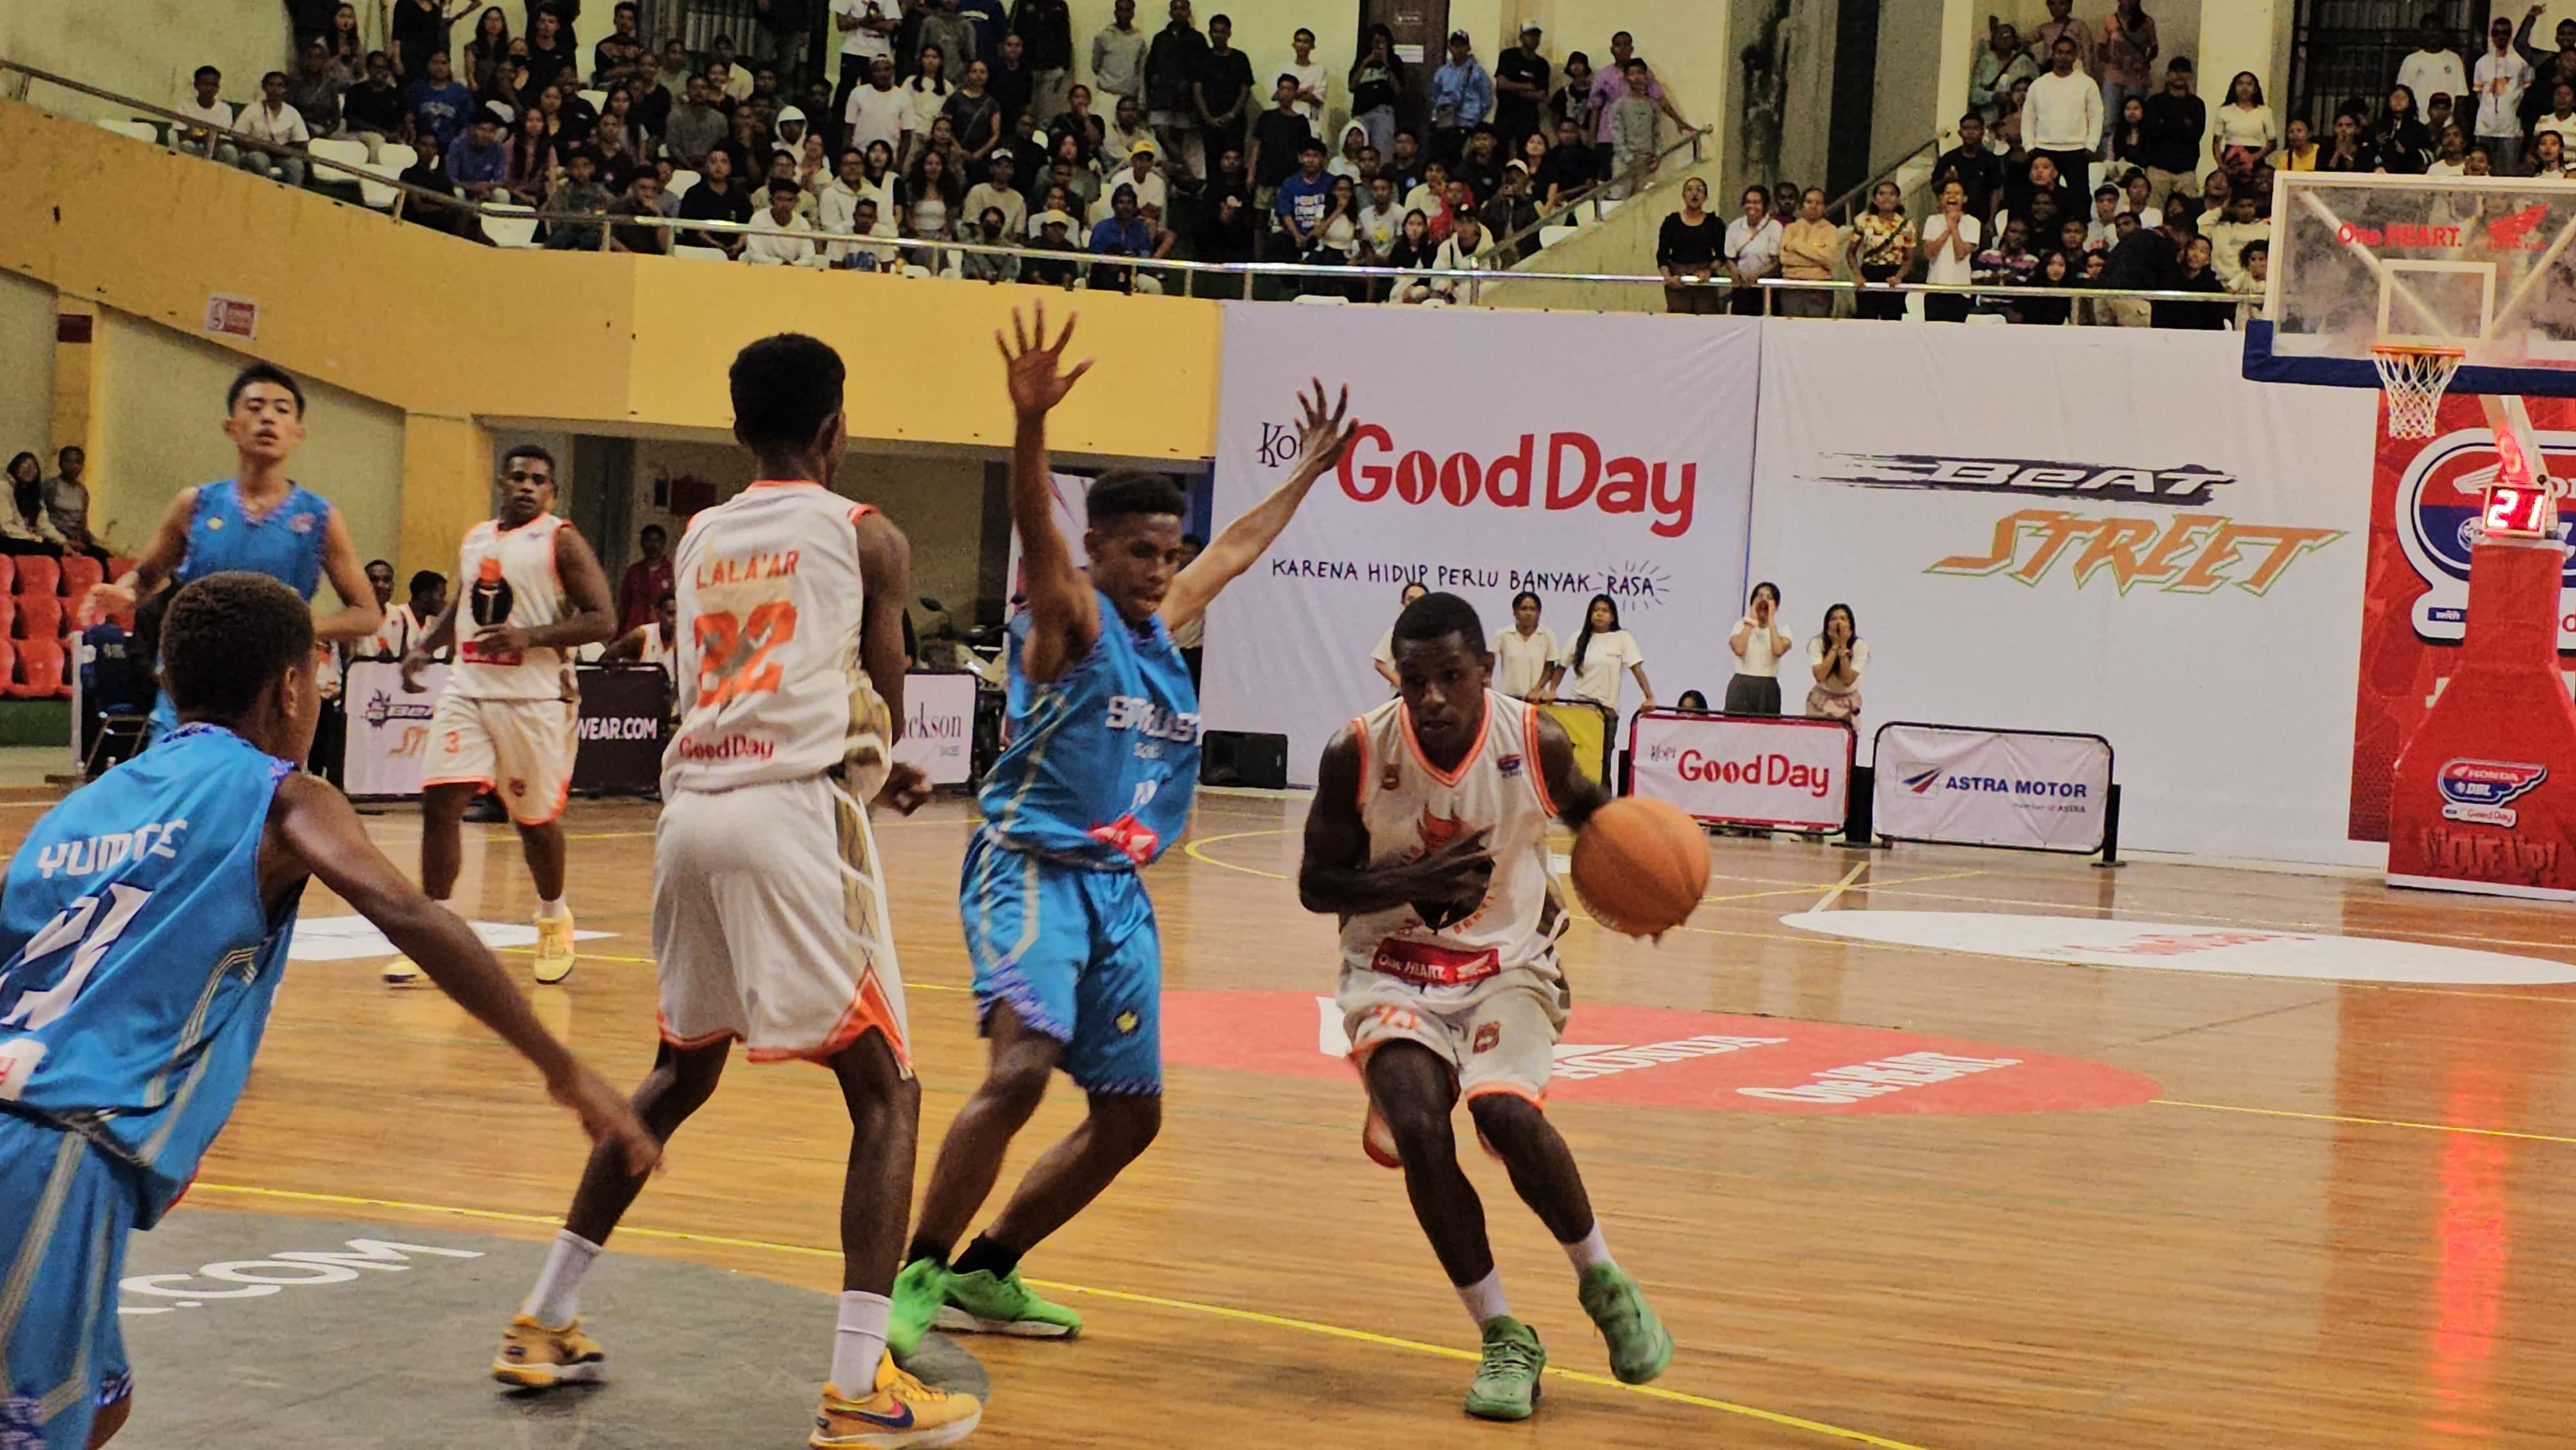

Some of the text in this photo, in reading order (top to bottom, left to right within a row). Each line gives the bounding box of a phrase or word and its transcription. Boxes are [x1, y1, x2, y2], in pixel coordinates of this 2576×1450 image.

[2337, 221, 2382, 245] One
[1336, 423, 1534, 507] Good
[1544, 431, 1697, 538] Day
[2486, 489, 2546, 529] 21
[696, 551, 800, 590] LALA'AR
[1922, 507, 2350, 598] STREET
[1272, 558, 1655, 597] KARENA HIDUP PERLU BANYAK RASA
[694, 601, 798, 709] 22
[444, 731, 461, 755] 3
[1678, 749, 1762, 784] Good
[1767, 754, 1830, 798] Day
[1946, 776, 2088, 798] ASTRA MOTOR
[37, 818, 188, 878] YUMTE
[117, 1238, 486, 1314] .COM
